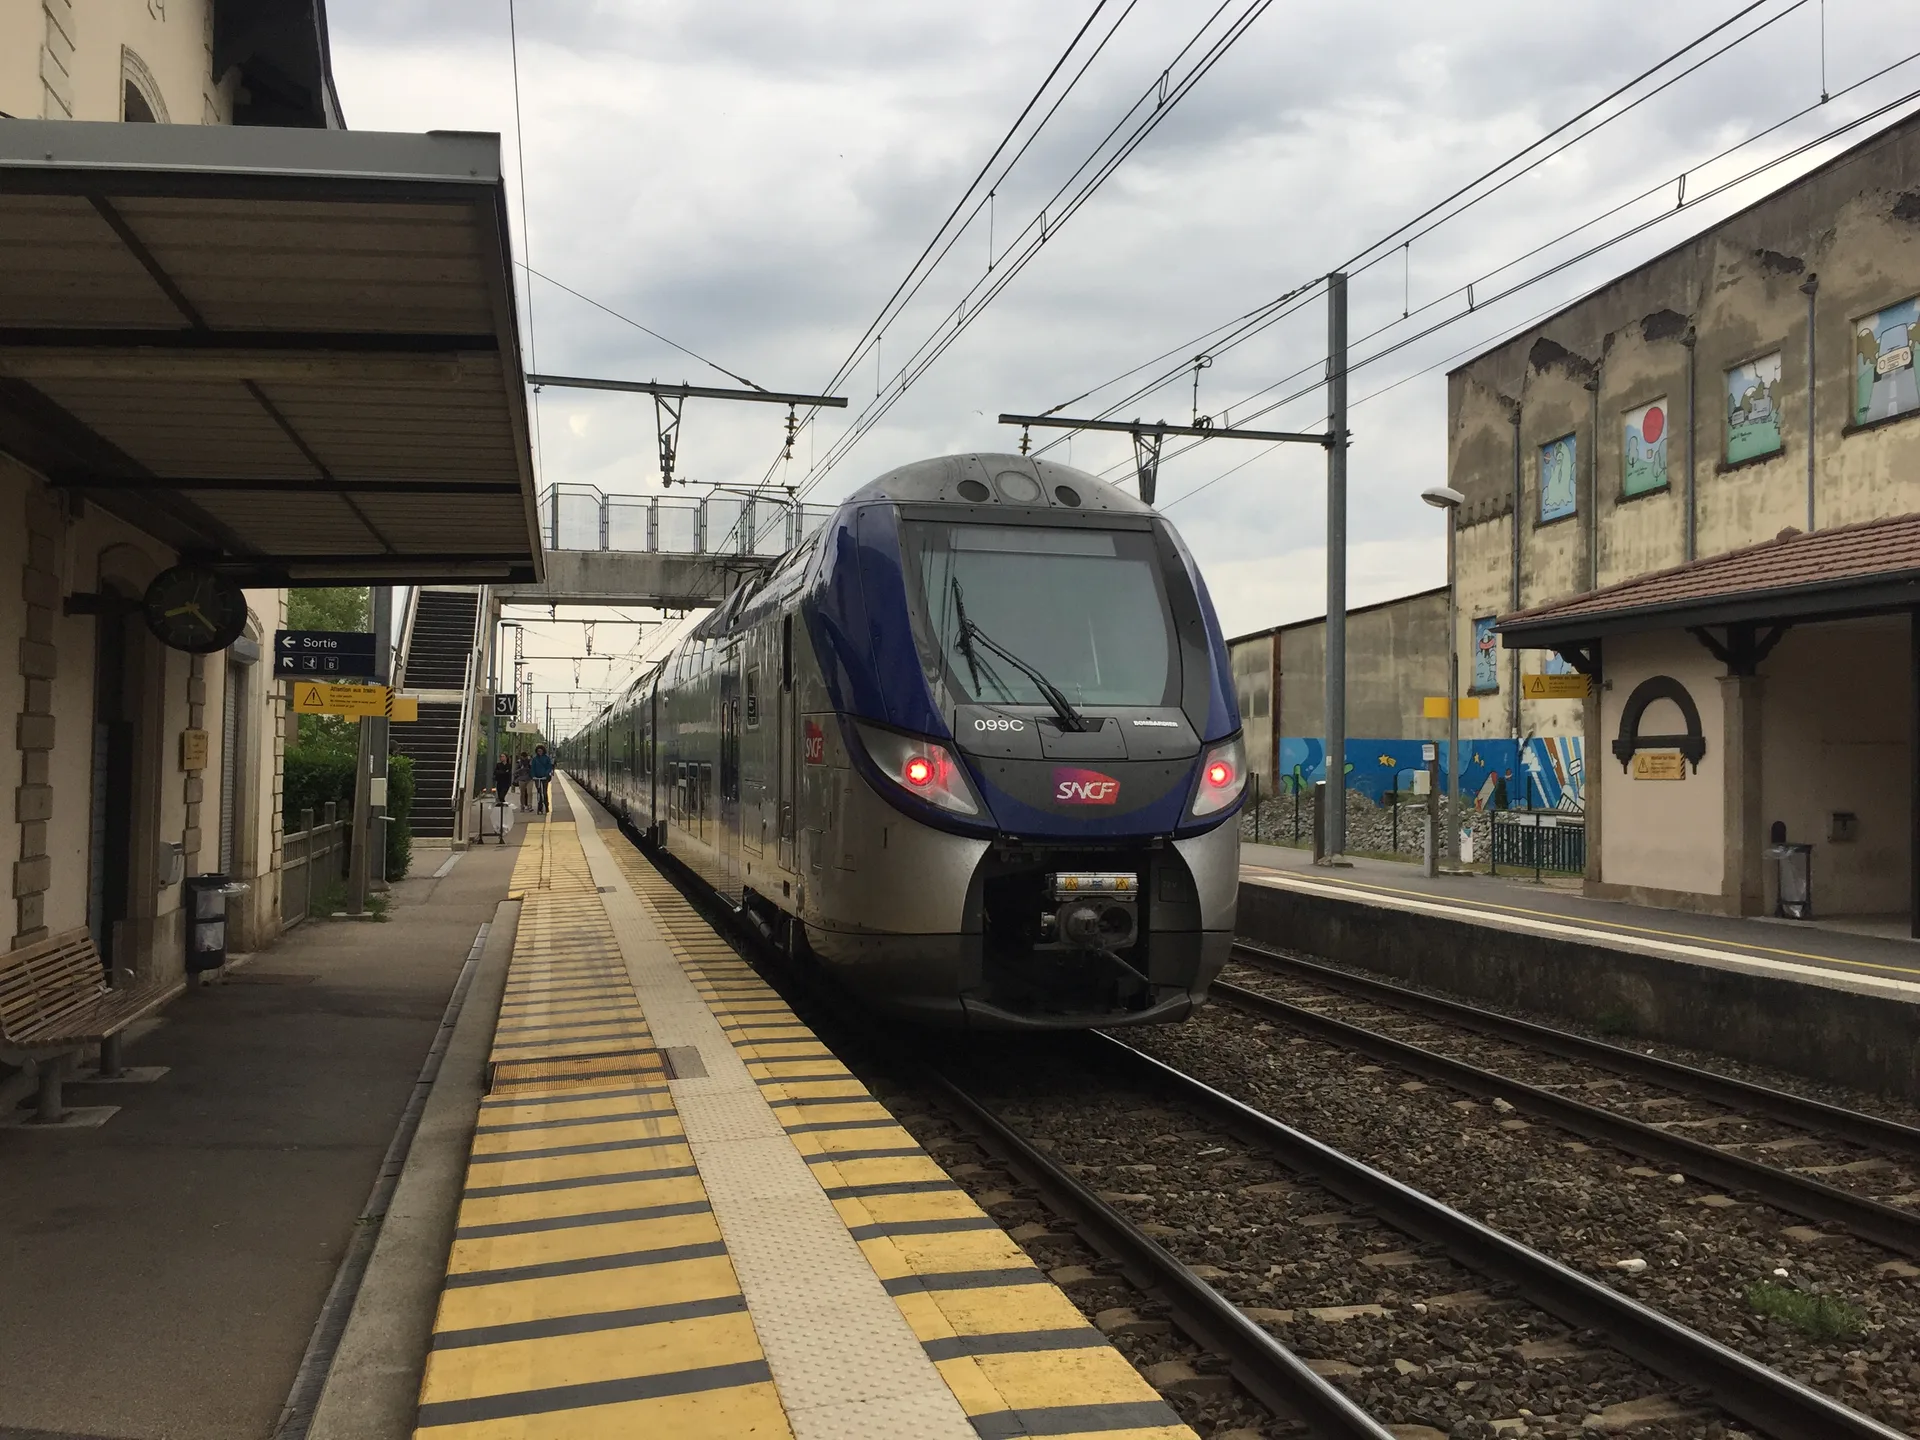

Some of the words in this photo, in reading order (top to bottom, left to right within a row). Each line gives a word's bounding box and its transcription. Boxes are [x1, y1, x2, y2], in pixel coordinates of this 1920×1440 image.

[303, 637, 338, 649] Sortie
[497, 697, 516, 712] 3V
[974, 719, 1024, 732] 099C
[806, 737, 822, 758] SNCF
[1056, 781, 1116, 800] SNCF
